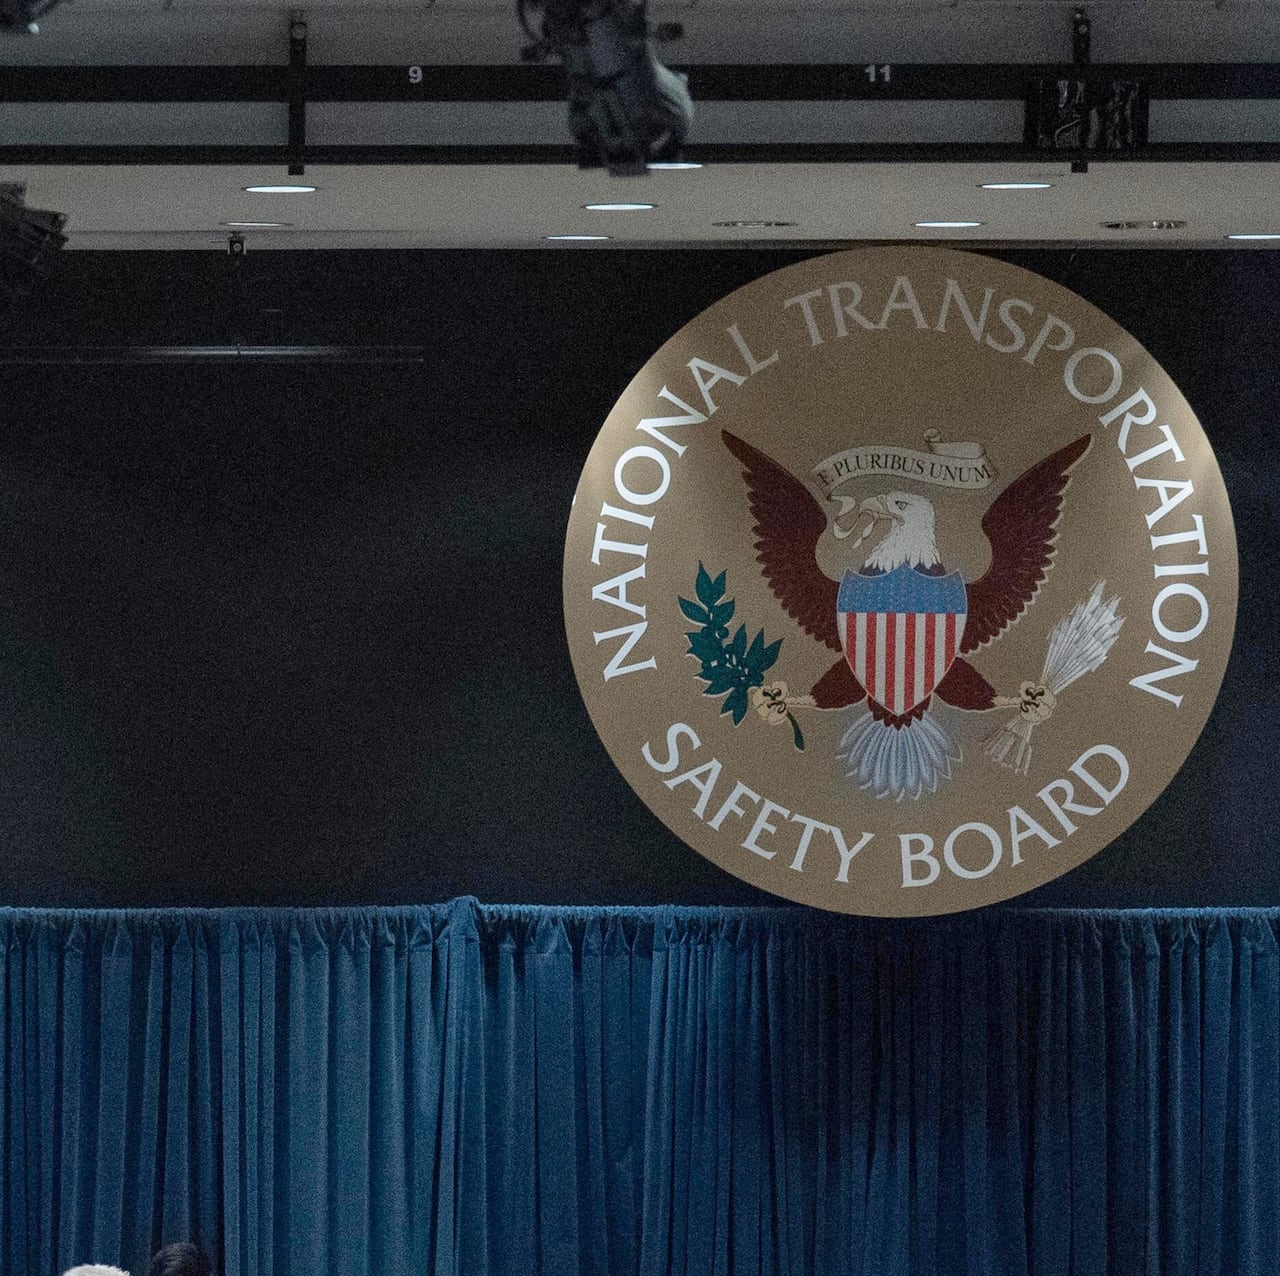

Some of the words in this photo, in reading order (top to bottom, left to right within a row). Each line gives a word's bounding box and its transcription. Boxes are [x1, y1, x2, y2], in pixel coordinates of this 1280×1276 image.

[408, 65, 423, 84] 9
[864, 64, 891, 82] 11
[833, 452, 925, 478] PLURIBUS
[929, 463, 992, 484] UNUM
[592, 324, 779, 682] NATIONAL
[784, 275, 1210, 708] TRANSPORTATION
[641, 722, 875, 884] SAFETY
[899, 743, 1131, 889] BOARD
